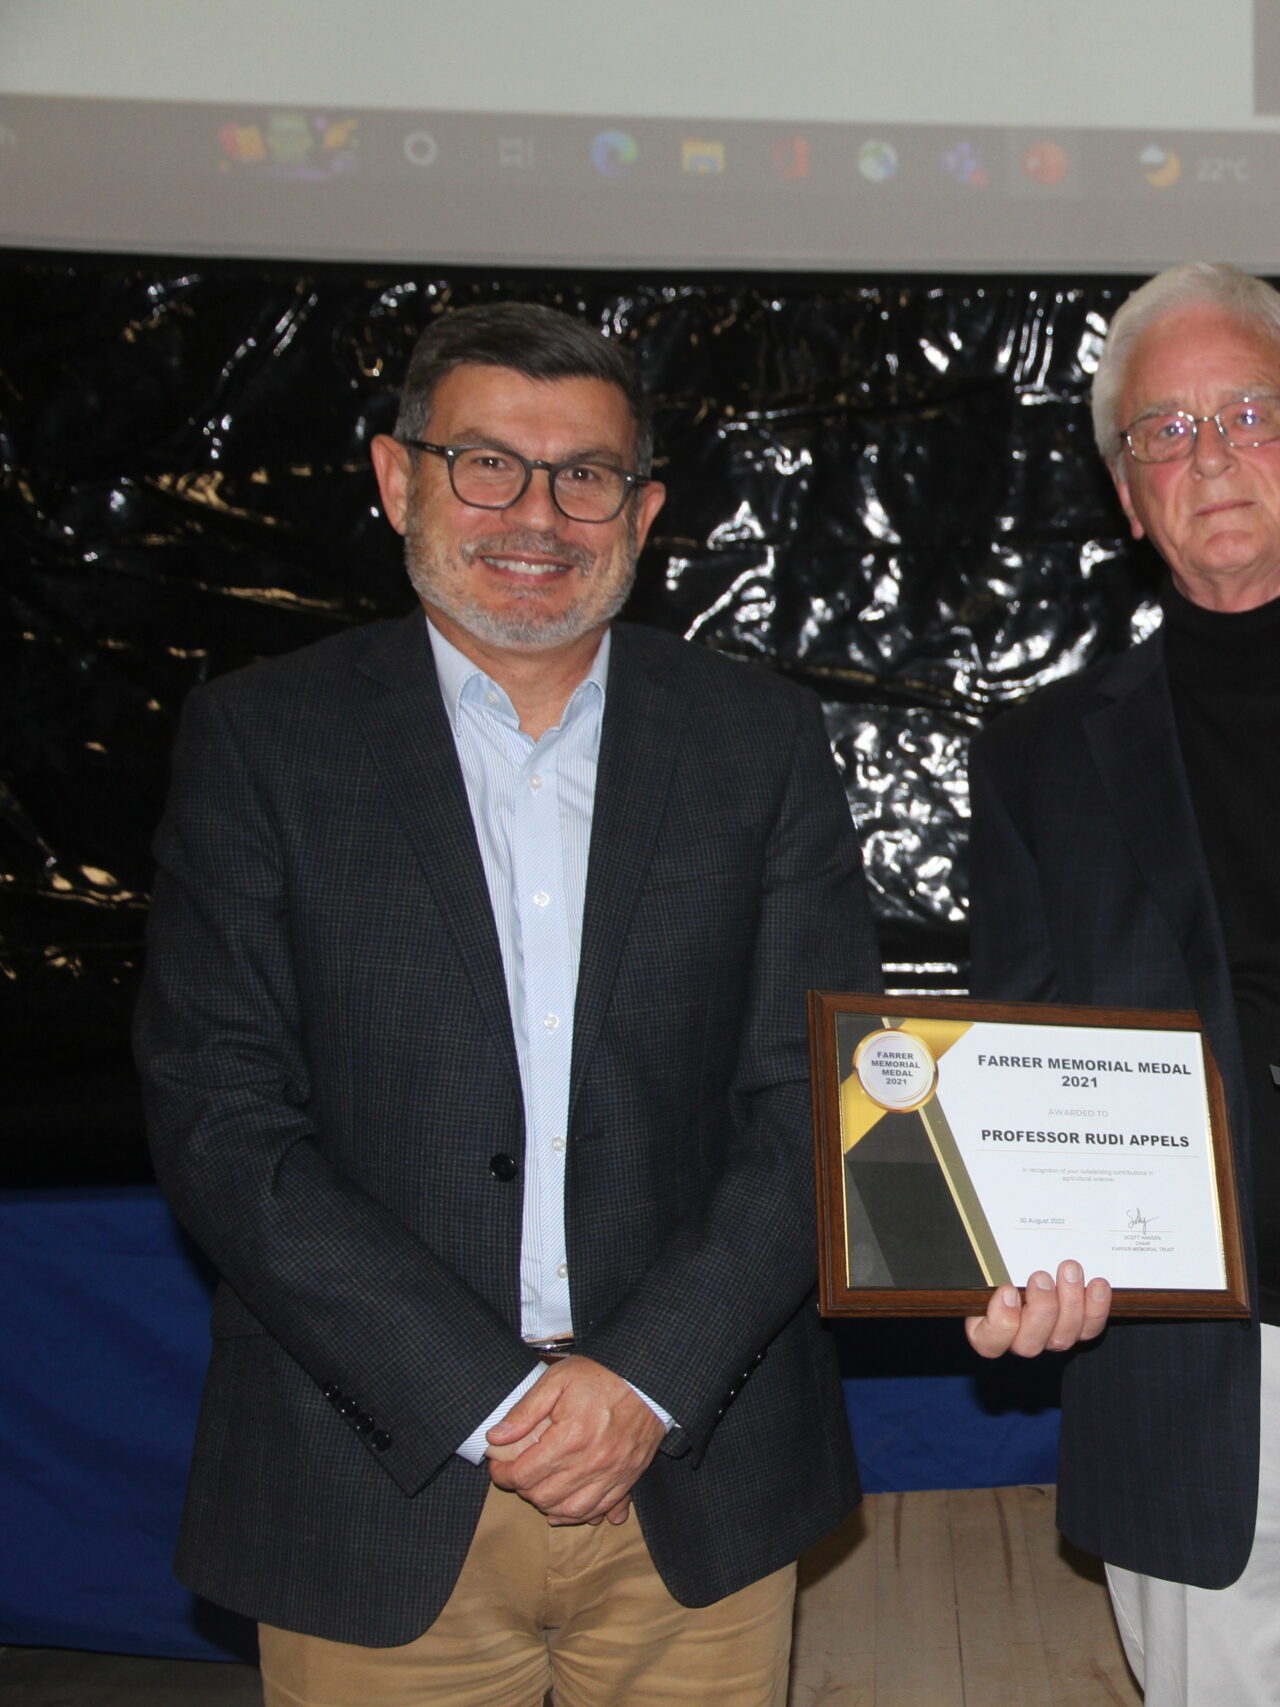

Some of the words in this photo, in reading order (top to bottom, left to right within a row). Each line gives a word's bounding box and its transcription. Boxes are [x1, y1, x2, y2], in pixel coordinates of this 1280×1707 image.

[877, 1051, 914, 1060] FARRER
[871, 1060, 920, 1069] MEMORIAL
[978, 1055, 1043, 1068] FARRER
[1048, 1058, 1133, 1073] MEMORIAL
[1138, 1062, 1192, 1075] MEDAL
[882, 1069, 914, 1077] MEDAL
[1061, 1076, 1098, 1088] 2021
[1048, 1108, 1095, 1118] AWARDED
[1097, 1110, 1109, 1118] TO
[981, 1129, 1080, 1144] PROFESSOR
[1085, 1132, 1124, 1146] RUDI
[1129, 1134, 1190, 1148] APPELS
[1028, 1217, 1048, 1225] August
